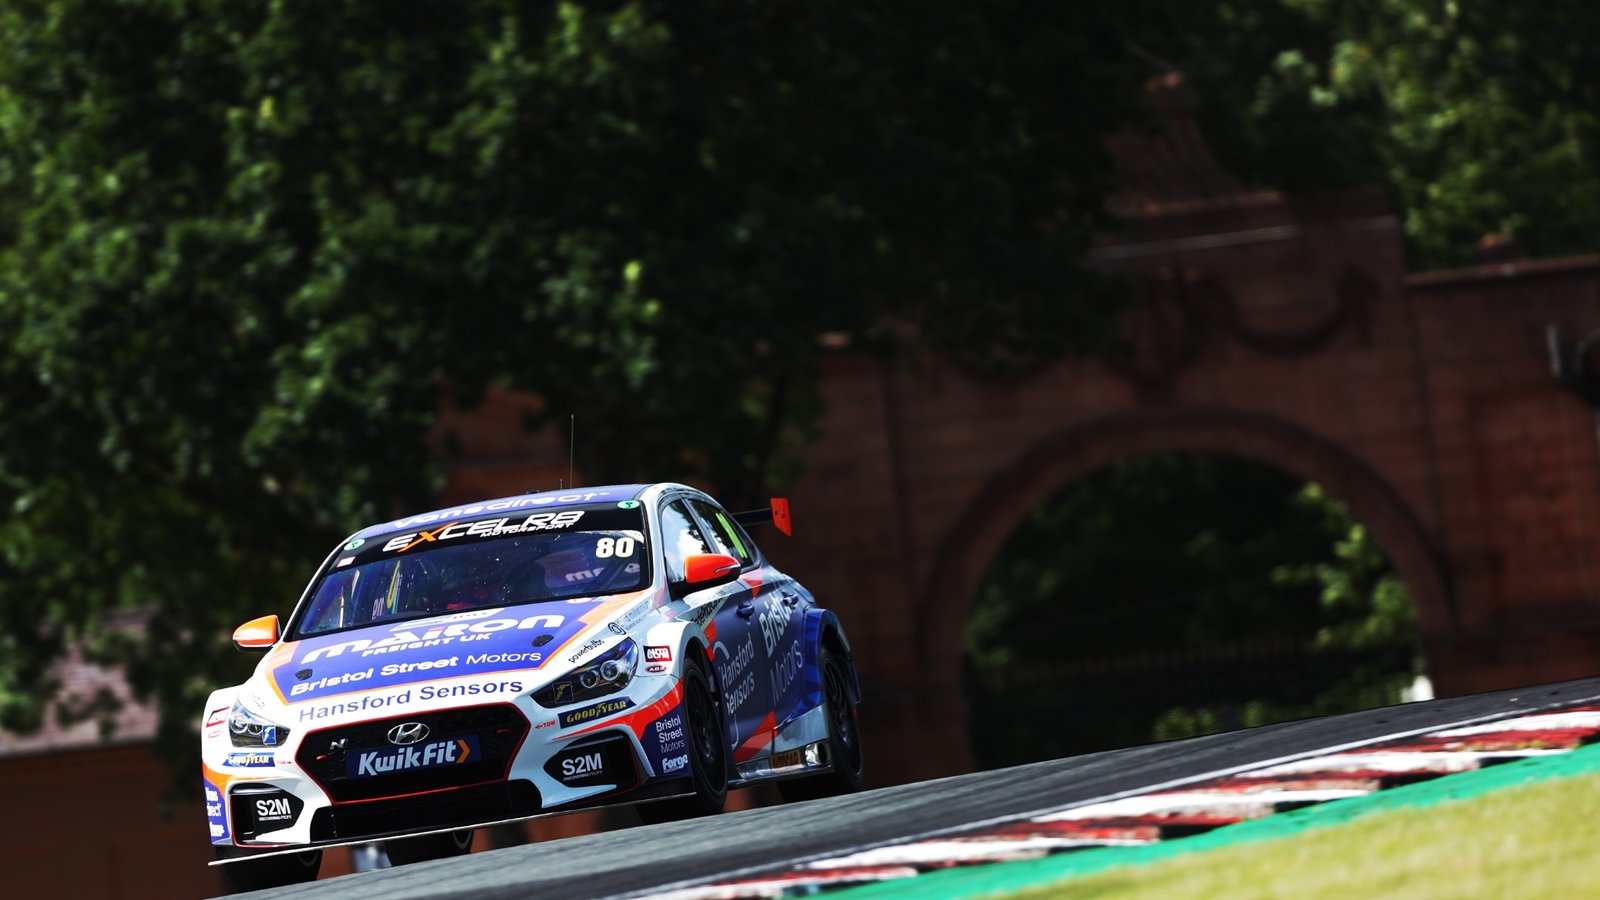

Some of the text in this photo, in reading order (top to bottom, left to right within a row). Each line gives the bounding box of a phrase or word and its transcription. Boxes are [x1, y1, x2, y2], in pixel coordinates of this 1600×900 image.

[382, 510, 585, 553] EXCELR8
[480, 522, 574, 538] MOTORSPORT
[595, 537, 635, 558] 80
[361, 632, 493, 657] FREIGHT UK
[290, 651, 542, 696] Bristol Street Motors
[770, 639, 803, 707] Motors
[299, 681, 523, 723] Hansford Sensors
[566, 701, 627, 724] GOODYEAR
[655, 715, 681, 732] Bristol
[658, 727, 684, 743] Street
[660, 739, 686, 754] Motors
[562, 753, 603, 776] S2M
[256, 798, 291, 816] S2M
